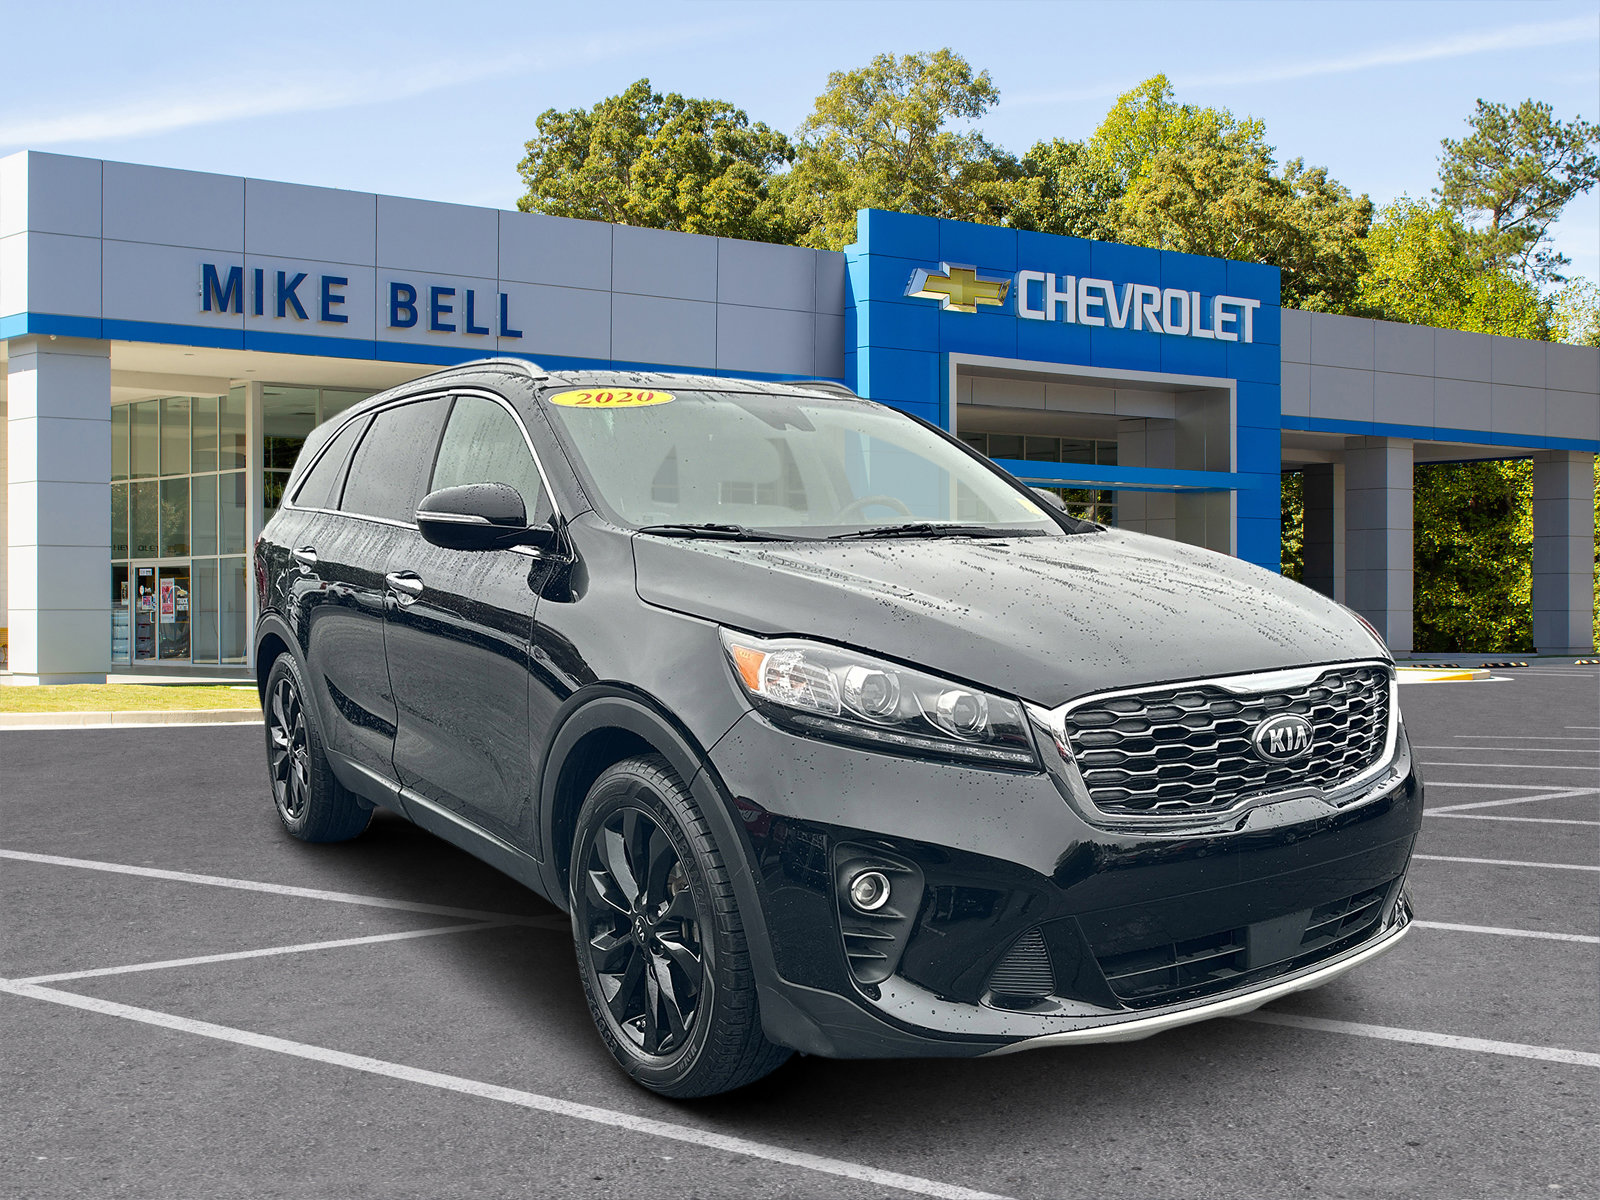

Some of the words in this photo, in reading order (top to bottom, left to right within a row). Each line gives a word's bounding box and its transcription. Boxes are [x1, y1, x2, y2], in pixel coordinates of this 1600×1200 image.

[200, 263, 348, 323] MIKE
[387, 281, 523, 339] BELL
[1014, 269, 1261, 343] CHEVROLET
[575, 391, 654, 405] 2020
[1268, 725, 1308, 753] KIA
